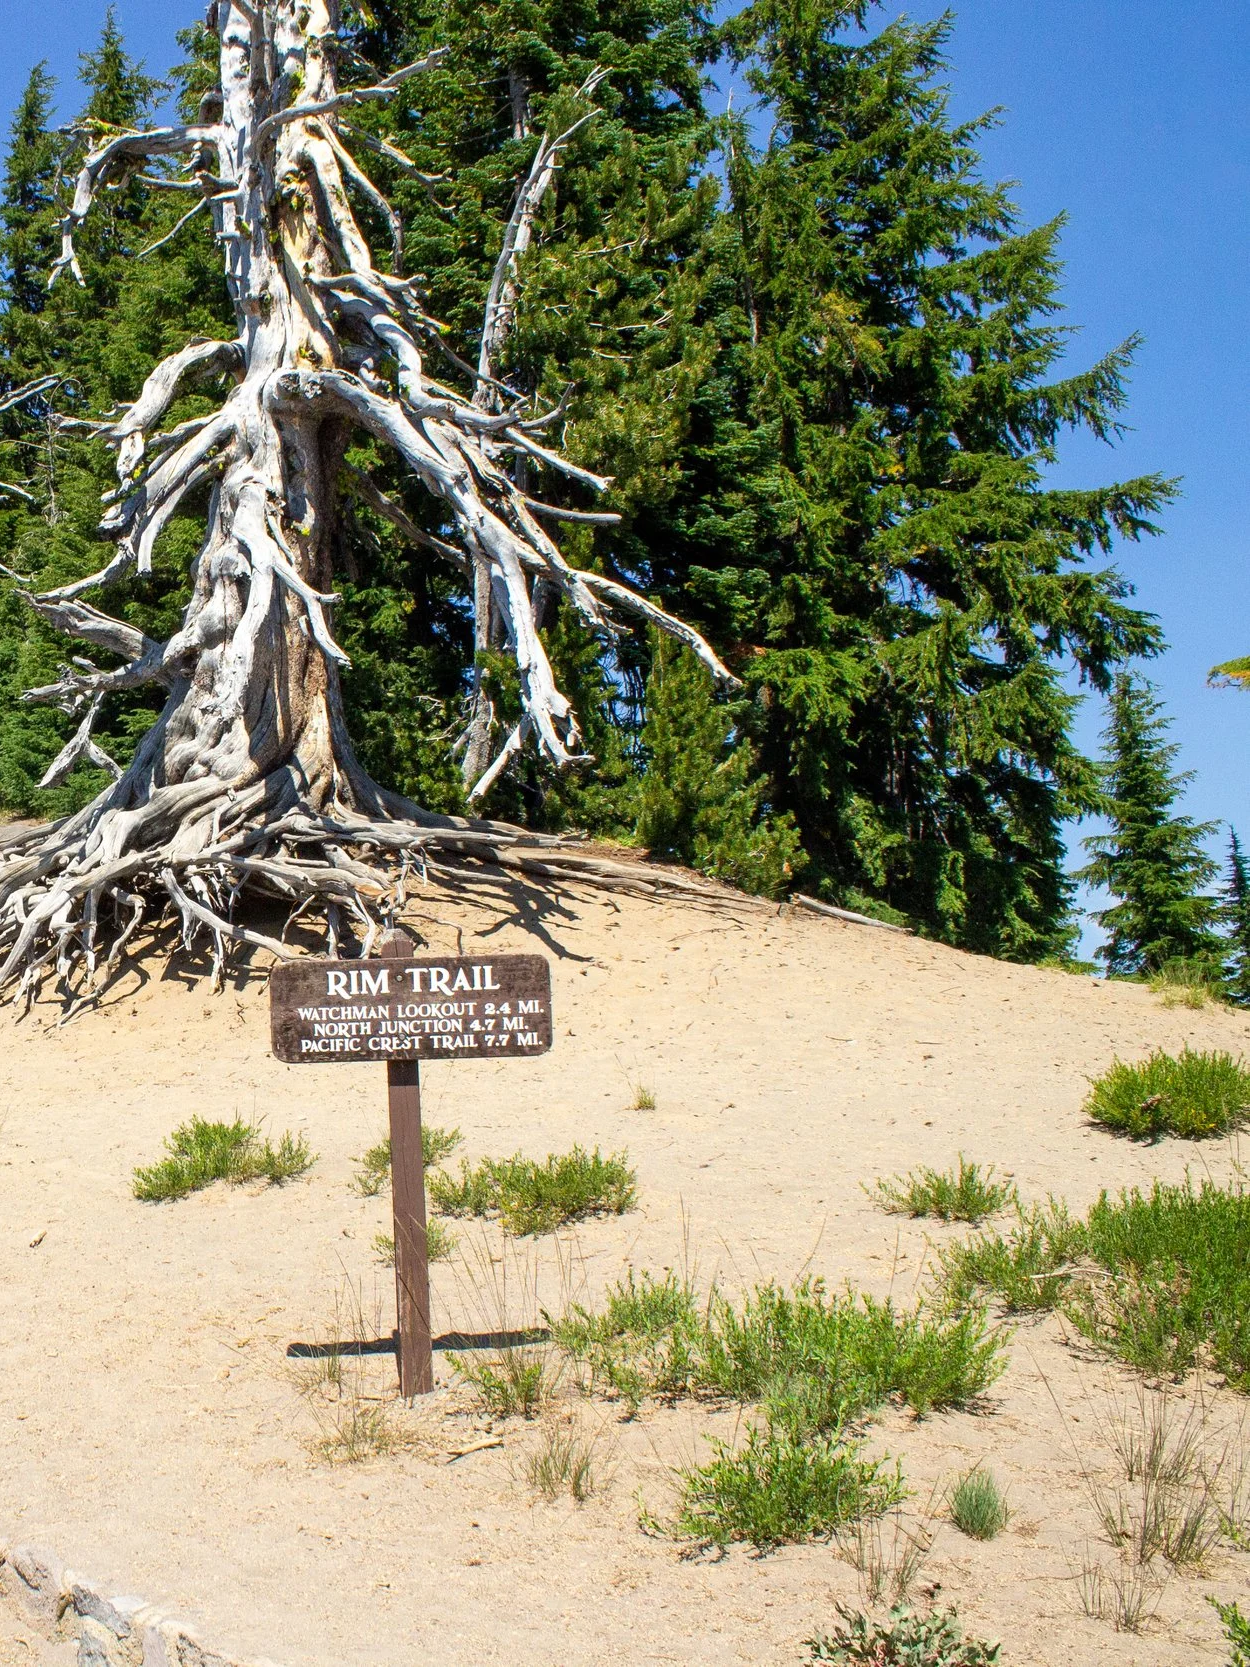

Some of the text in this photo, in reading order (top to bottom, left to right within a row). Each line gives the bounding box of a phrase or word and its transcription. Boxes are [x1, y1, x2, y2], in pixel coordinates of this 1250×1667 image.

[327, 966, 500, 999] RIM TRAIL
[298, 1000, 544, 1020] WATCHMAN LOOKOUT 2.4 MI.
[314, 1017, 528, 1037] NORTH JUNCTION 4.7 MI.
[302, 1033, 542, 1052] PACIFIC CREST TRAIL 7.7 MI.
